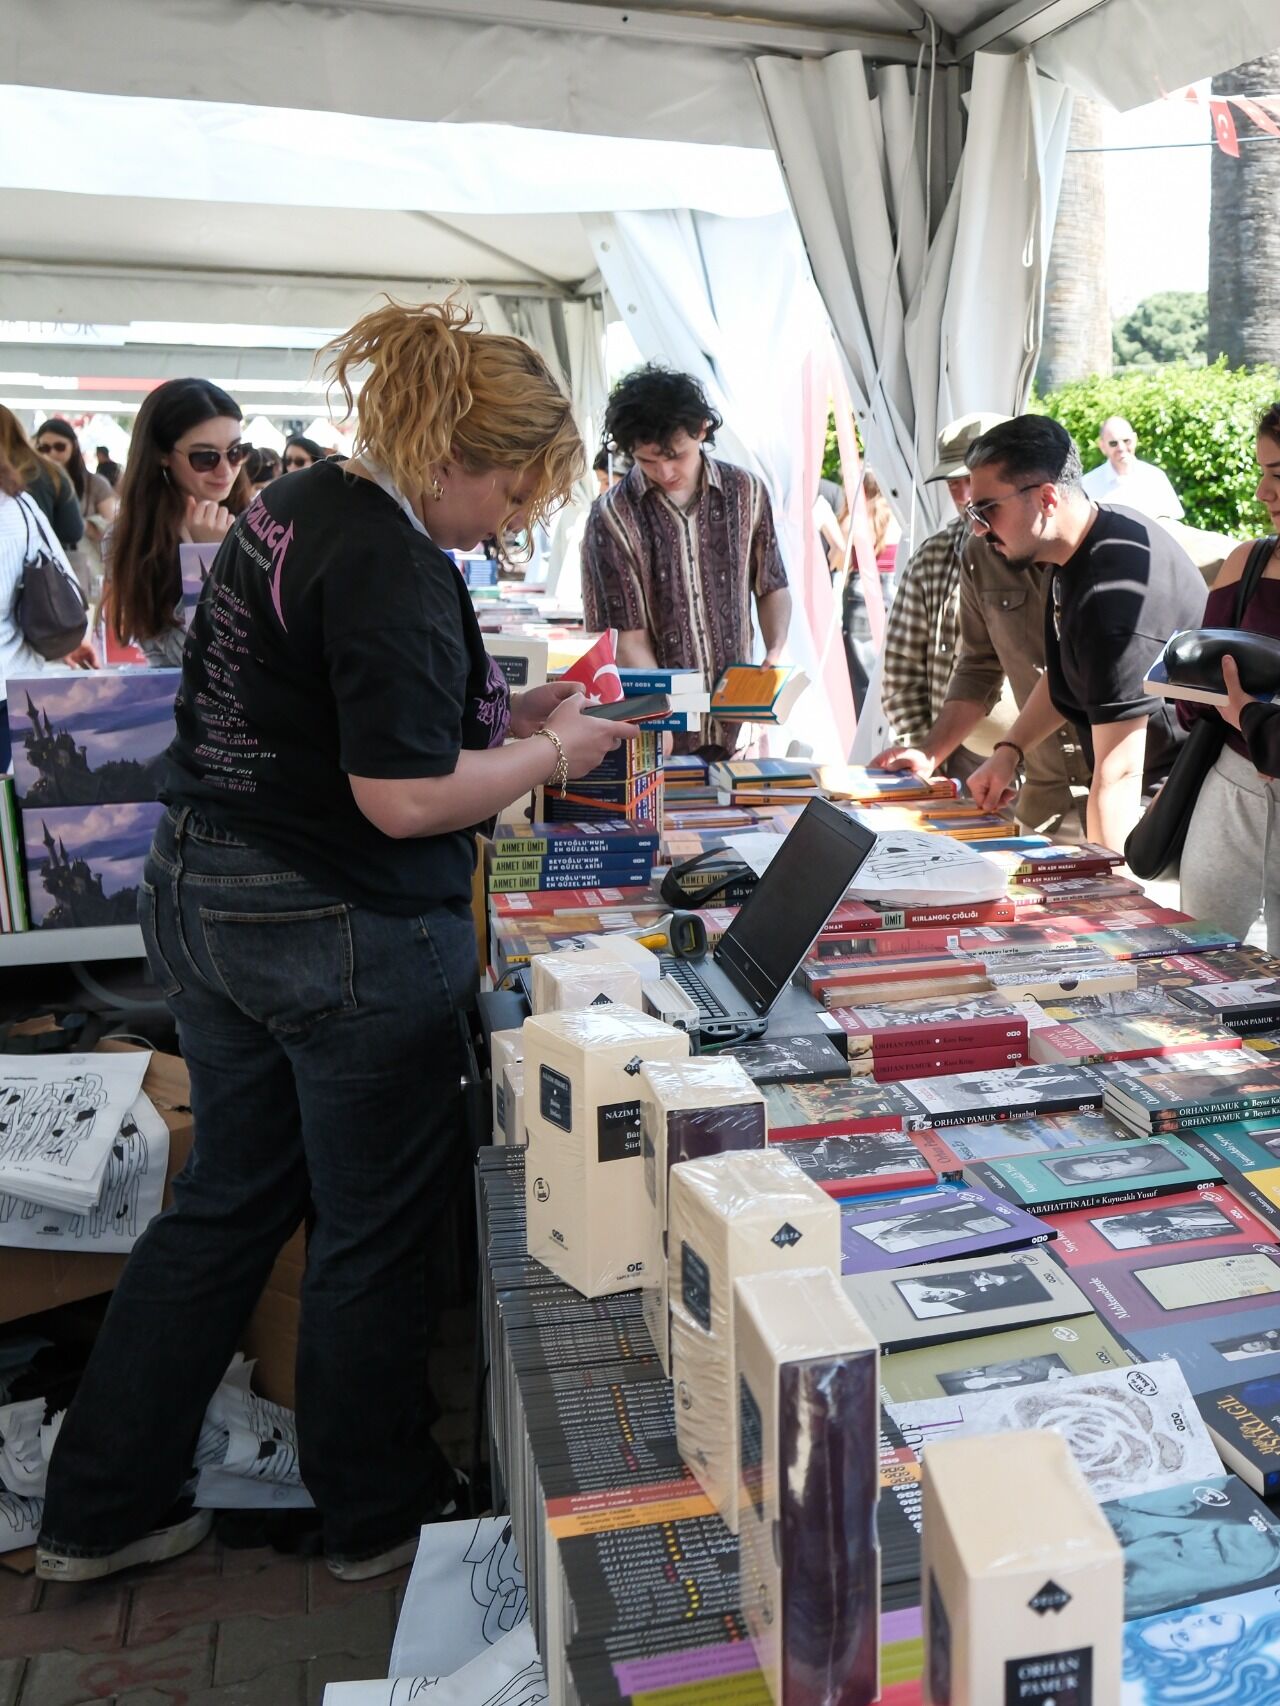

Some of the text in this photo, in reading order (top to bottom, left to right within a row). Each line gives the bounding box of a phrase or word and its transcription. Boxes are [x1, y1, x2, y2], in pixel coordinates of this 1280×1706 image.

[502, 840, 544, 853] AHMET ÜMİT
[496, 858, 539, 871] AHMET ÜMİT
[494, 876, 536, 888] AHMET ÜMİT
[681, 875, 704, 884] AHMET
[884, 911, 978, 926] ÜMİT KIRLANGIÇ ÇIĞLIĞI
[1224, 1020, 1249, 1028] ORHAN
[1250, 1016, 1273, 1026] PAMUK
[874, 1041, 904, 1050] ORHAN
[876, 1064, 904, 1073] ORHAN
[606, 1108, 634, 1120] NÂZIM
[1180, 1106, 1210, 1116] ORHAN
[1210, 1102, 1240, 1112] PAMUK
[1252, 1099, 1270, 1108] Beyaz
[934, 1110, 1037, 1128] ORHAN PAMUK İstanbul
[1181, 1117, 1212, 1128] ORHAN
[1212, 1112, 1240, 1123] PAMUK
[1252, 1109, 1270, 1118] Beyaz
[1026, 1189, 1158, 1214] SABAHATTİN ALİ Kuyucaklı Yusuf
[1018, 1657, 1080, 1680] ORHAN
[1020, 1674, 1078, 1697] PAMUK
